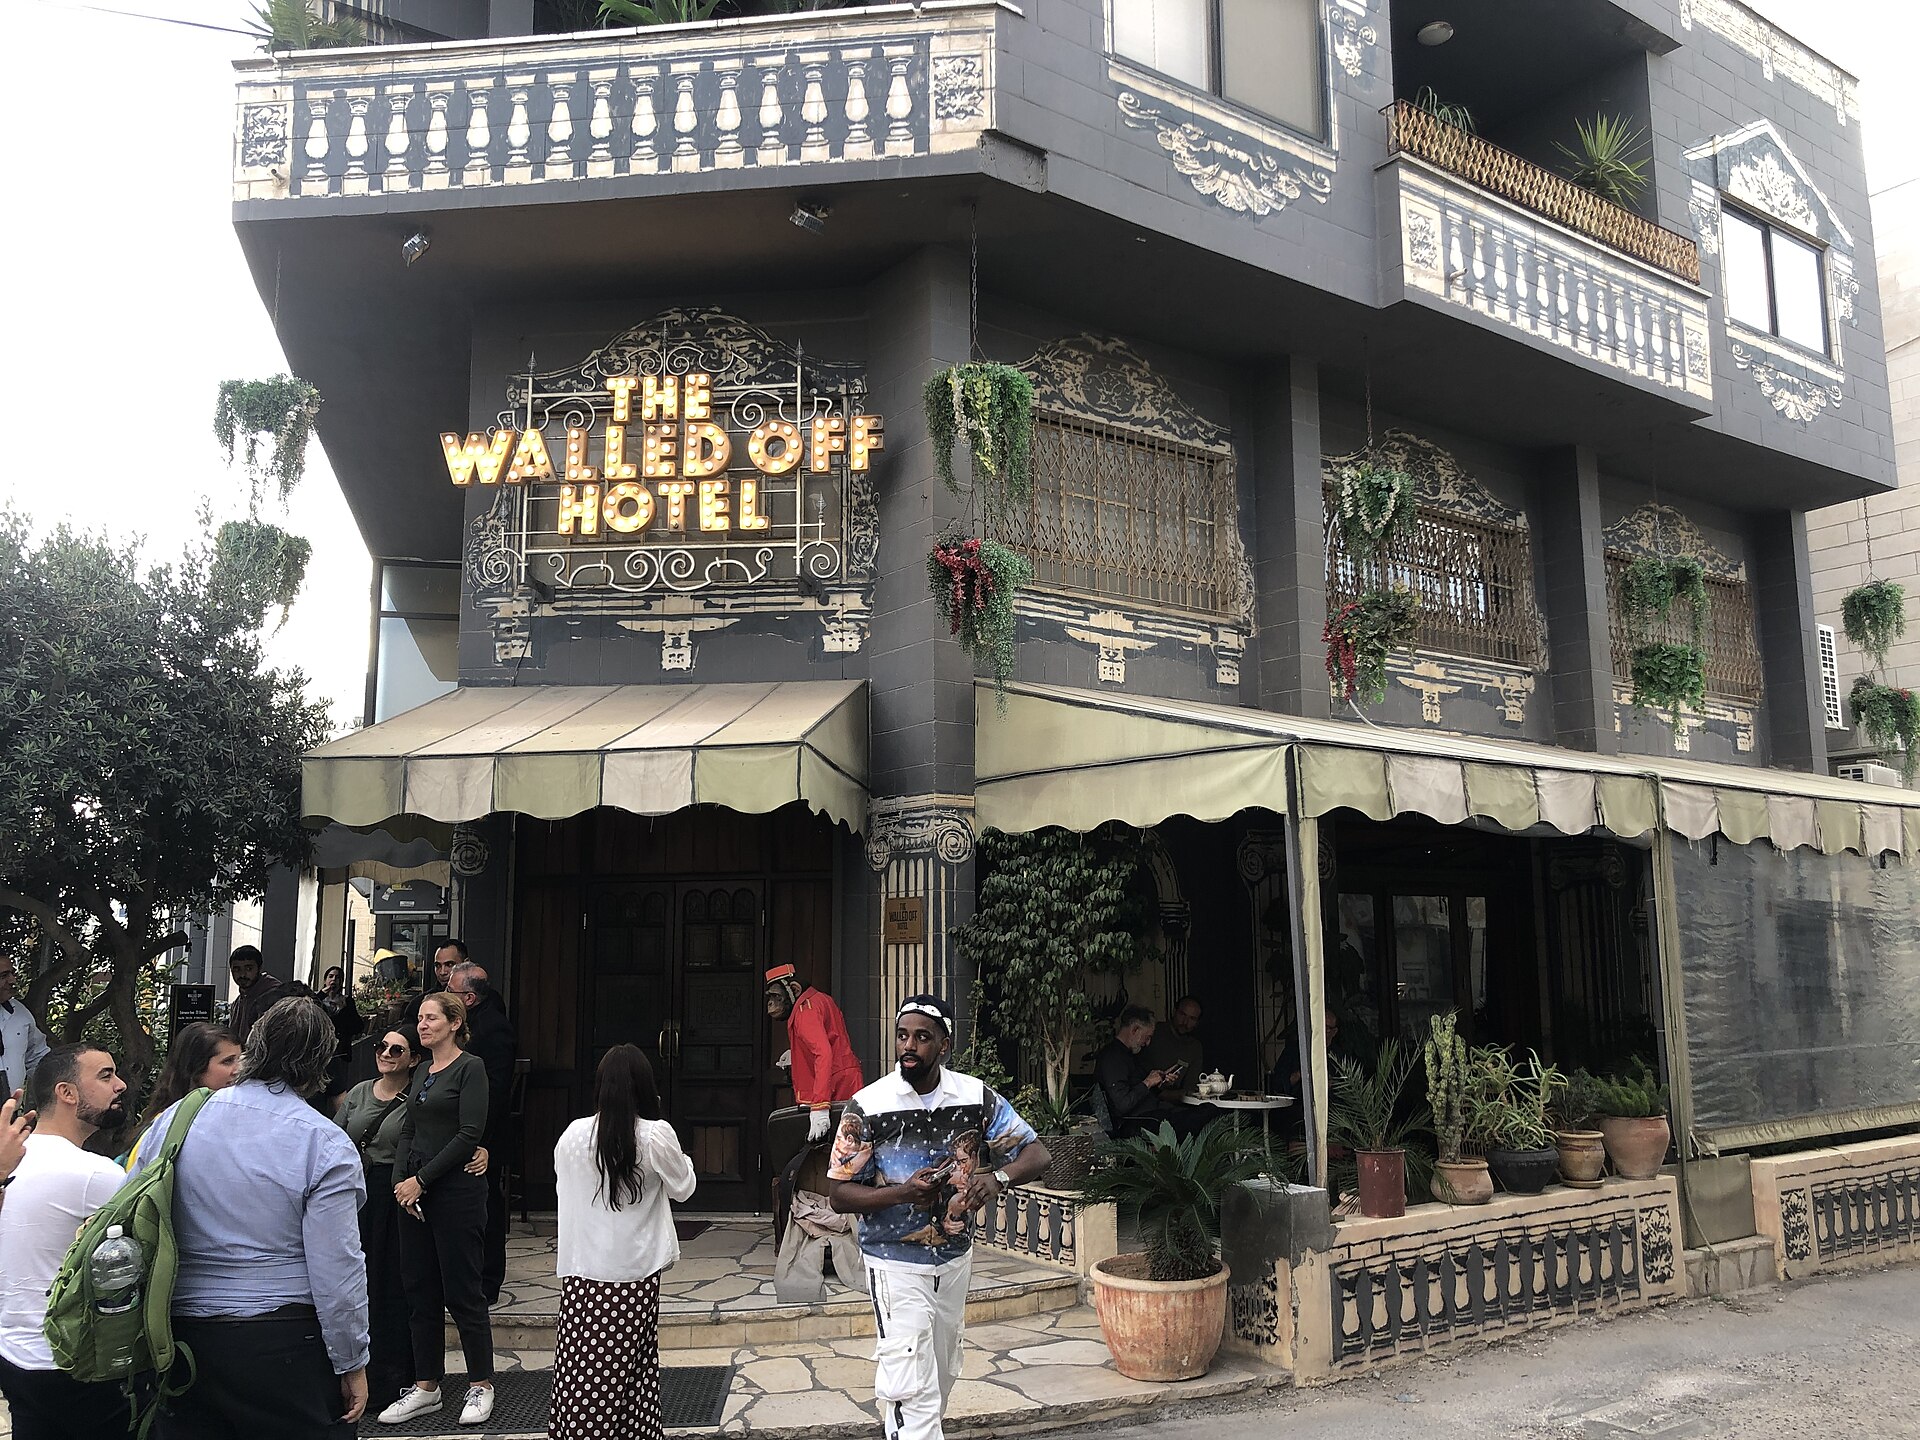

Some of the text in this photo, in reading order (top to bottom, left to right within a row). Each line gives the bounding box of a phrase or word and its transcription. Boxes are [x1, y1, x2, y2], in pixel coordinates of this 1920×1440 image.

[607, 373, 714, 424] THE
[439, 414, 885, 487] WALLED OFF
[557, 479, 771, 536] HOTEL
[889, 910, 918, 922] WALLED OFF
